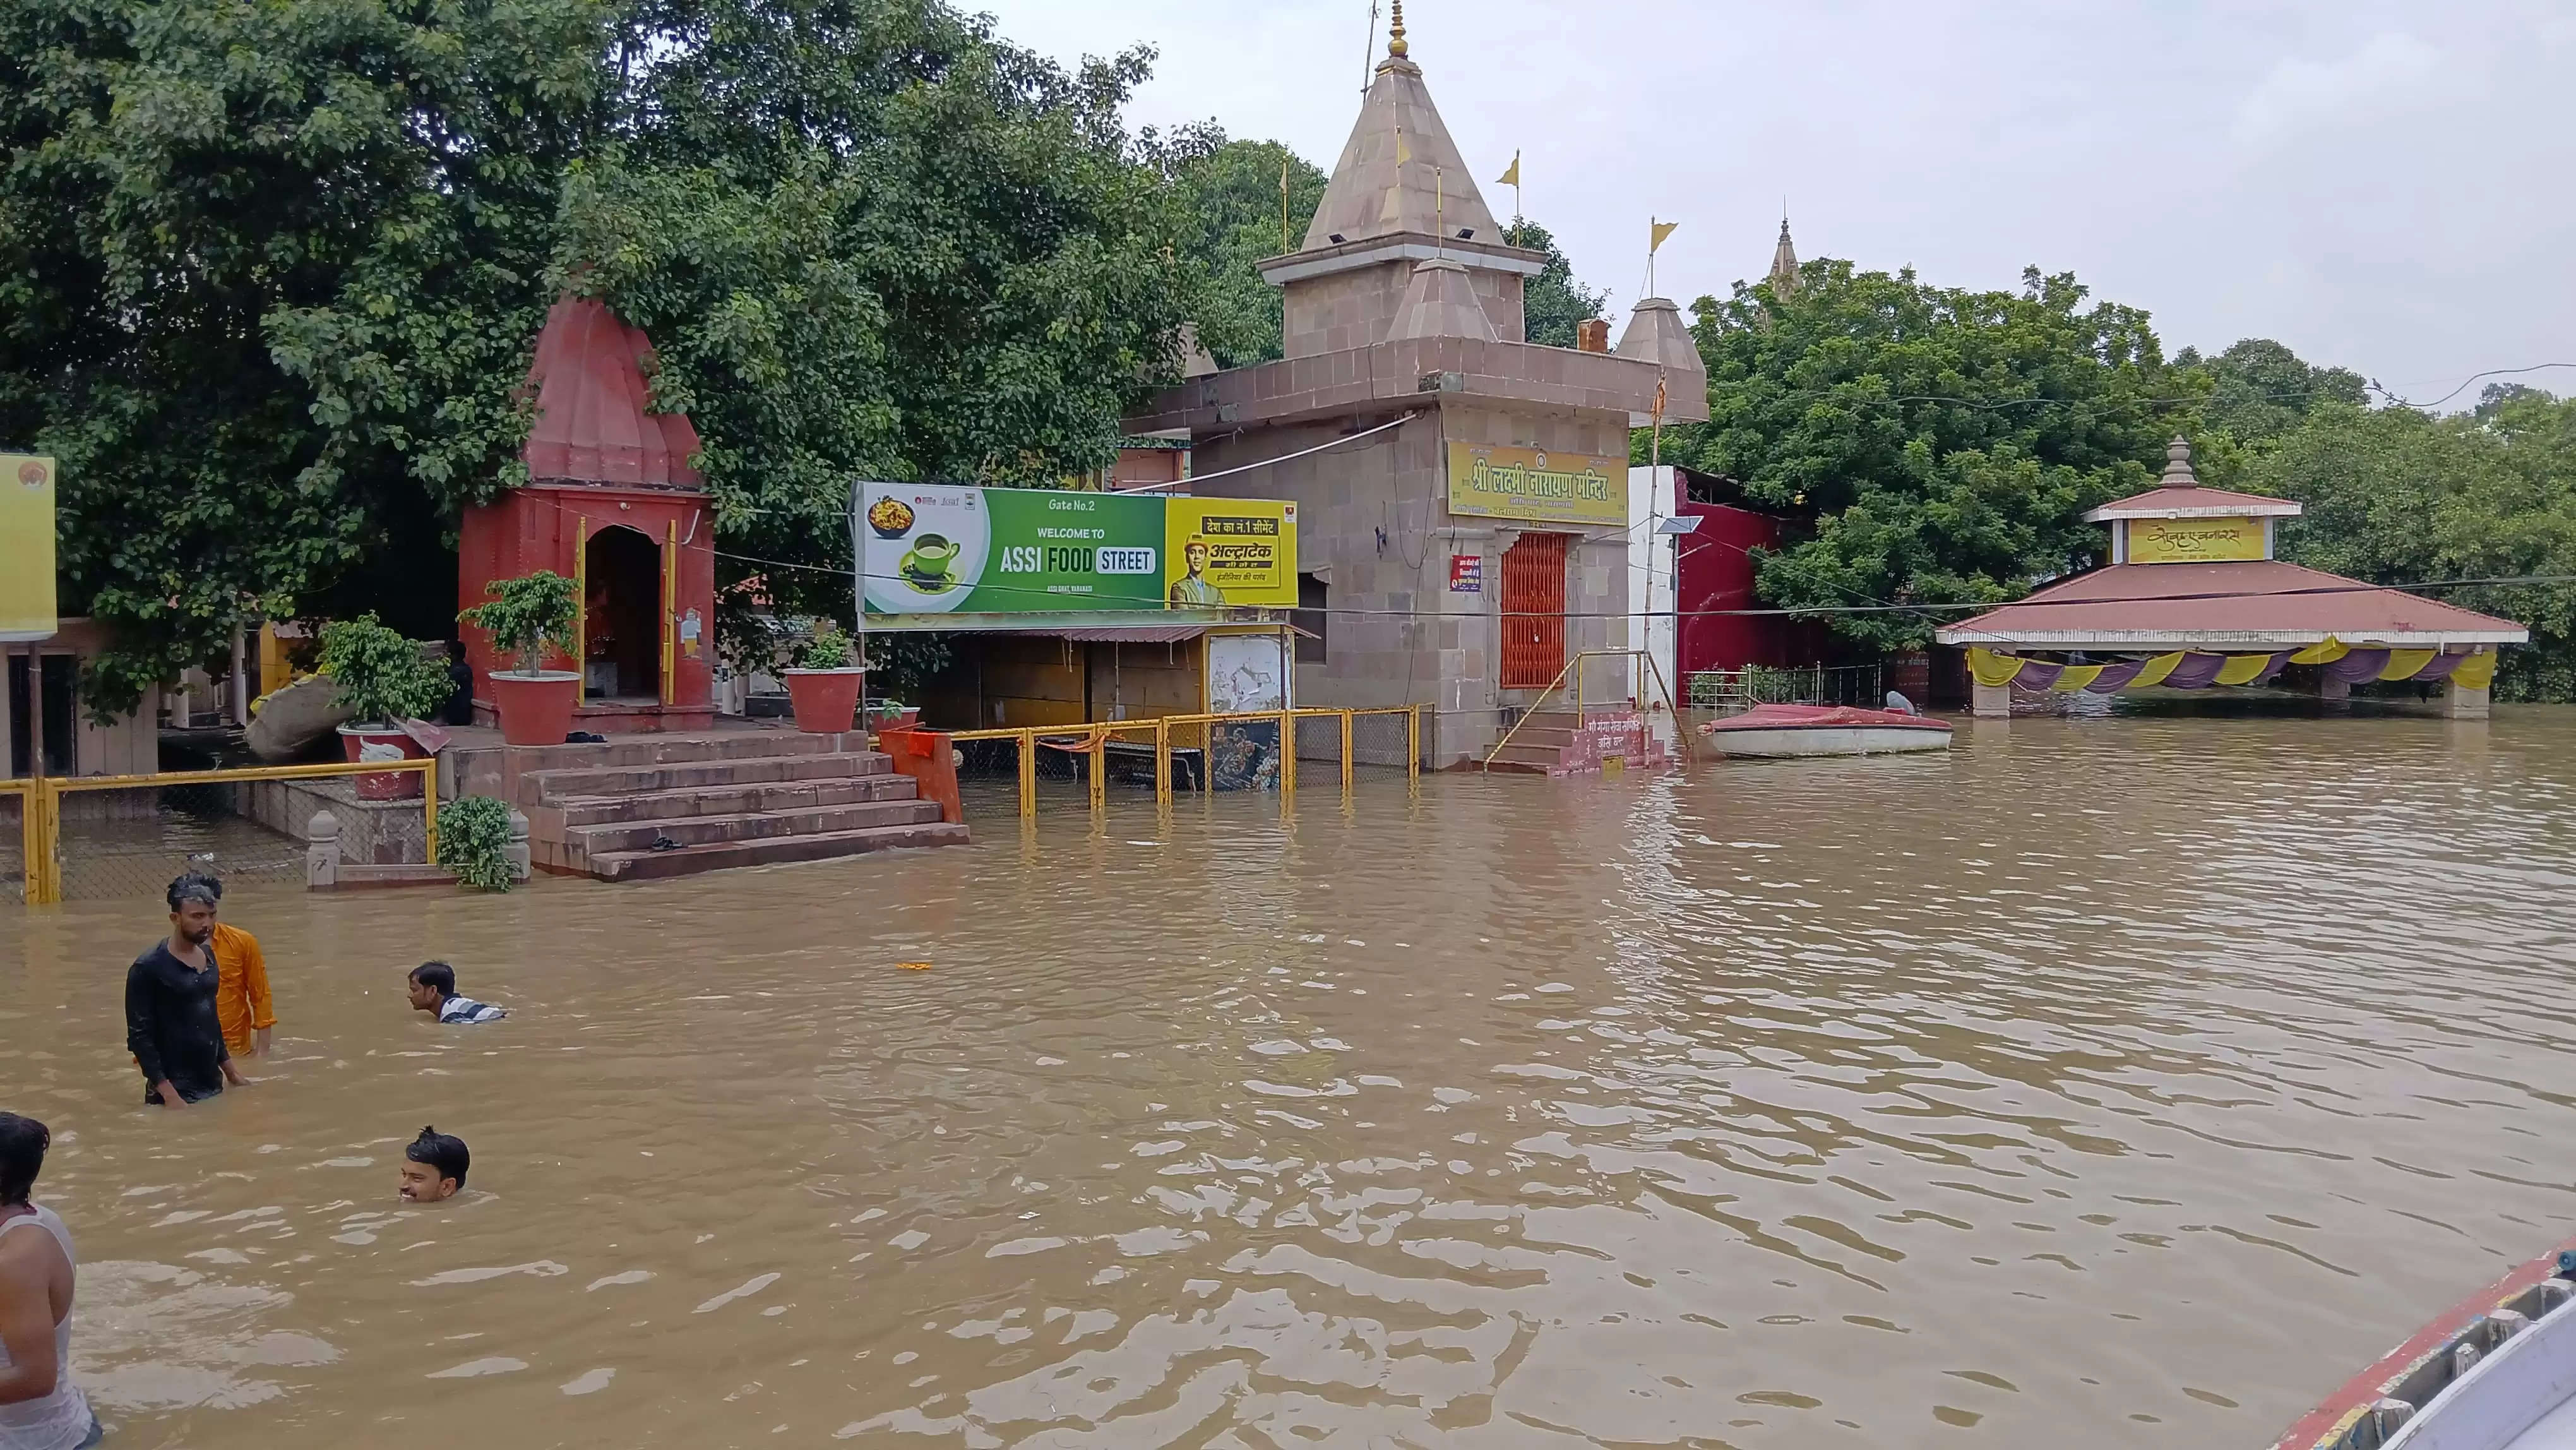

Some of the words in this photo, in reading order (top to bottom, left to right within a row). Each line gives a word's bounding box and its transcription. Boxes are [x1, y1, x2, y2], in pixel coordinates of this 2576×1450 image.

[1472, 457, 1489, 491] श्री
[1491, 461, 1526, 495] लक्ष्मी
[1529, 470, 1573, 498] नारायण
[1575, 467, 1608, 501] मन्दिर
[1049, 499, 1072, 510] Gate
[1073, 500, 1095, 511] No.2
[1037, 527, 1089, 538] WELCOME
[1092, 529, 1104, 539] TO
[1207, 518, 1220, 532] देश
[1223, 521, 1234, 532] का
[1253, 519, 1273, 533] सीमेंट
[1210, 542, 1272, 560] अल्ट्राटेक
[1000, 546, 1041, 572] ASSI
[1047, 547, 1092, 573] FOOD
[1102, 551, 1150, 570] STREET
